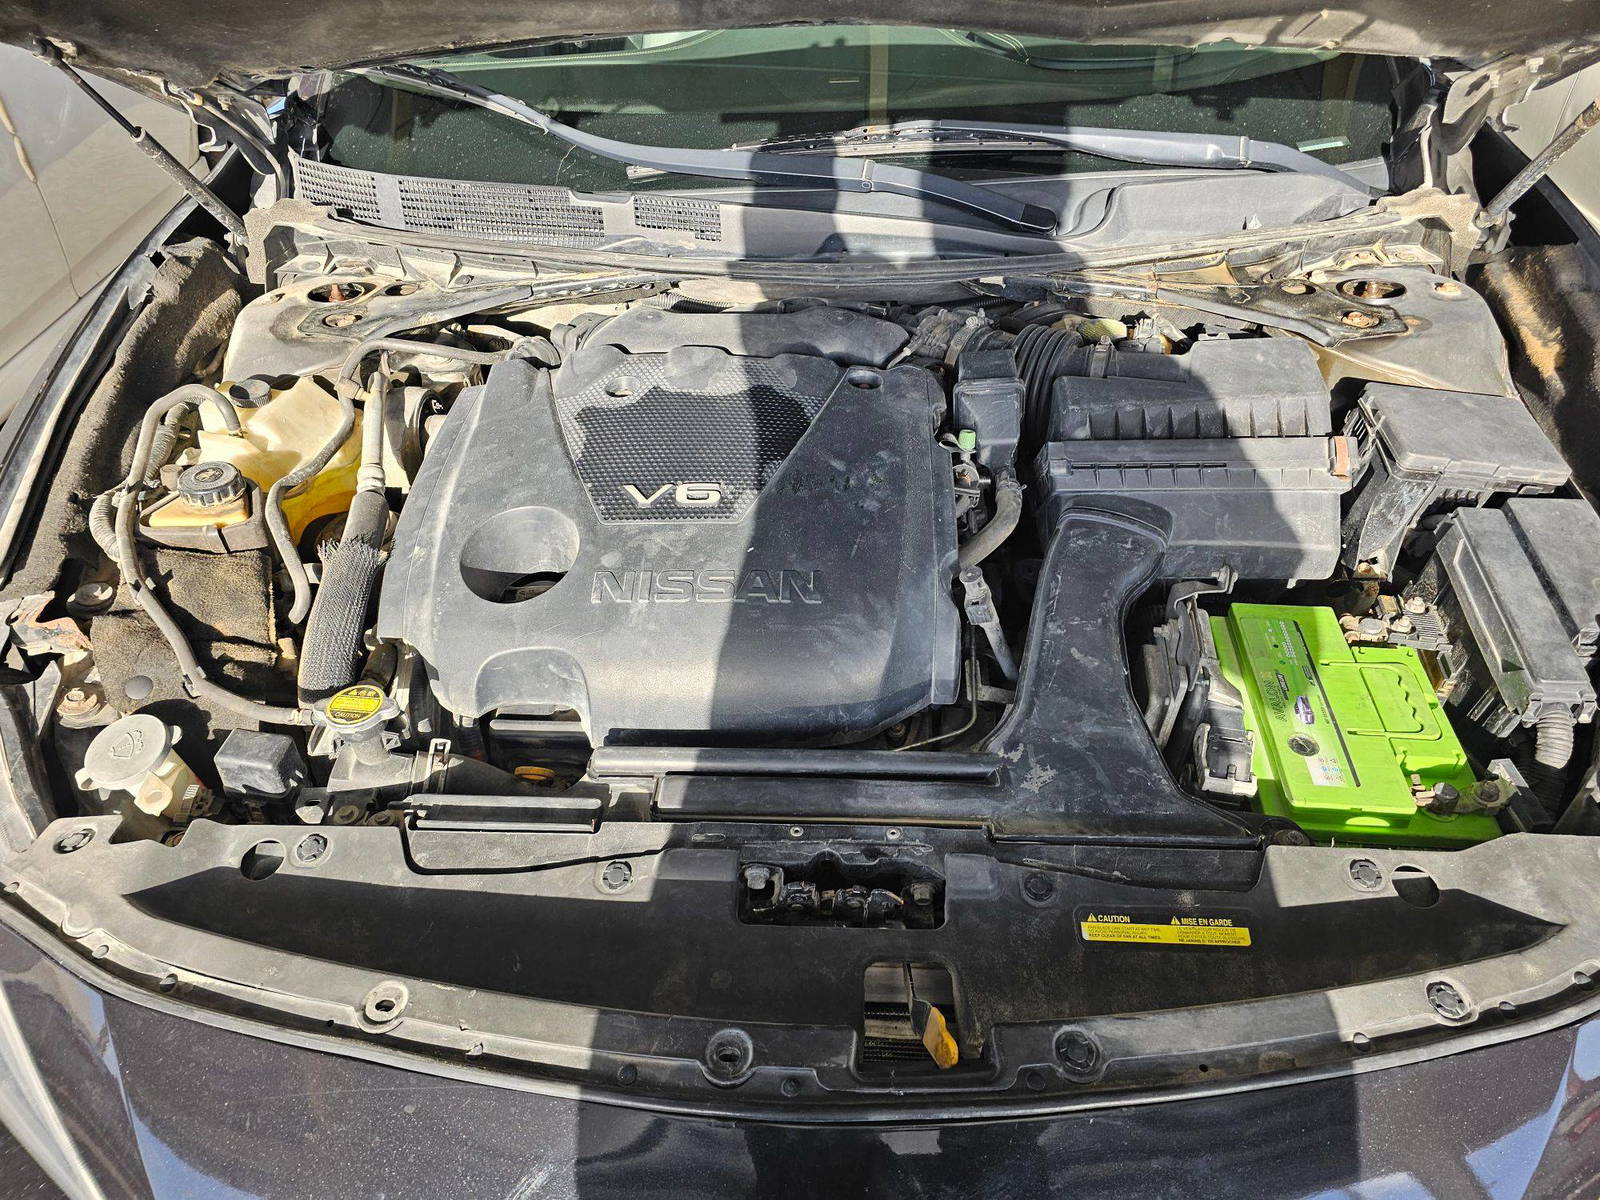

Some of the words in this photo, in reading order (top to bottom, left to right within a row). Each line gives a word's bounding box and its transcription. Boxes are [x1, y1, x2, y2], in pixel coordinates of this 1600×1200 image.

[623, 481, 722, 508] V6
[590, 569, 823, 604] NISSAN
[1097, 914, 1131, 923] CAUTION
[1181, 917, 1198, 926] MISE
[1199, 917, 1209, 926] EN
[1209, 918, 1233, 927] GARDE
